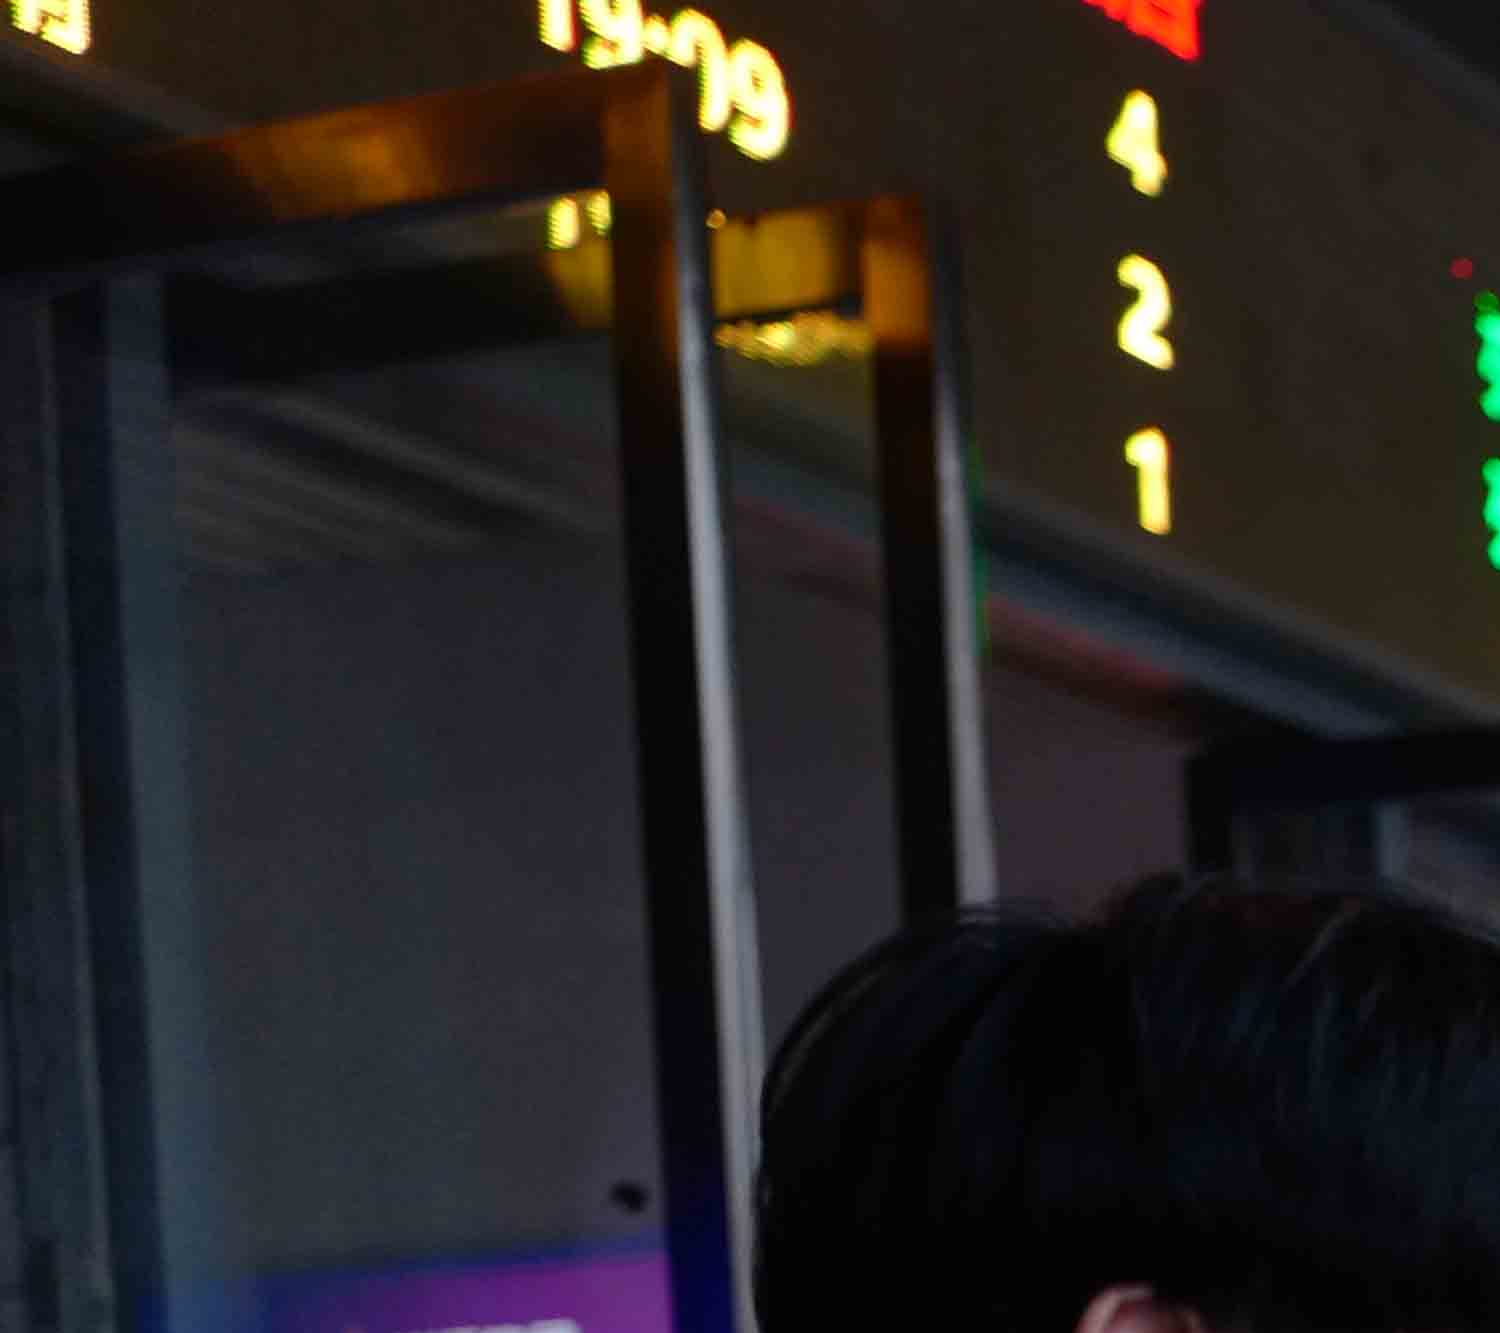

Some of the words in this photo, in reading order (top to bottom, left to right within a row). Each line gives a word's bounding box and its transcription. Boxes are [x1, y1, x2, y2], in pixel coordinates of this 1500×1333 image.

[1106, 90, 1167, 197] 4
[1116, 254, 1175, 370] 2
[1124, 427, 1171, 535] 1
